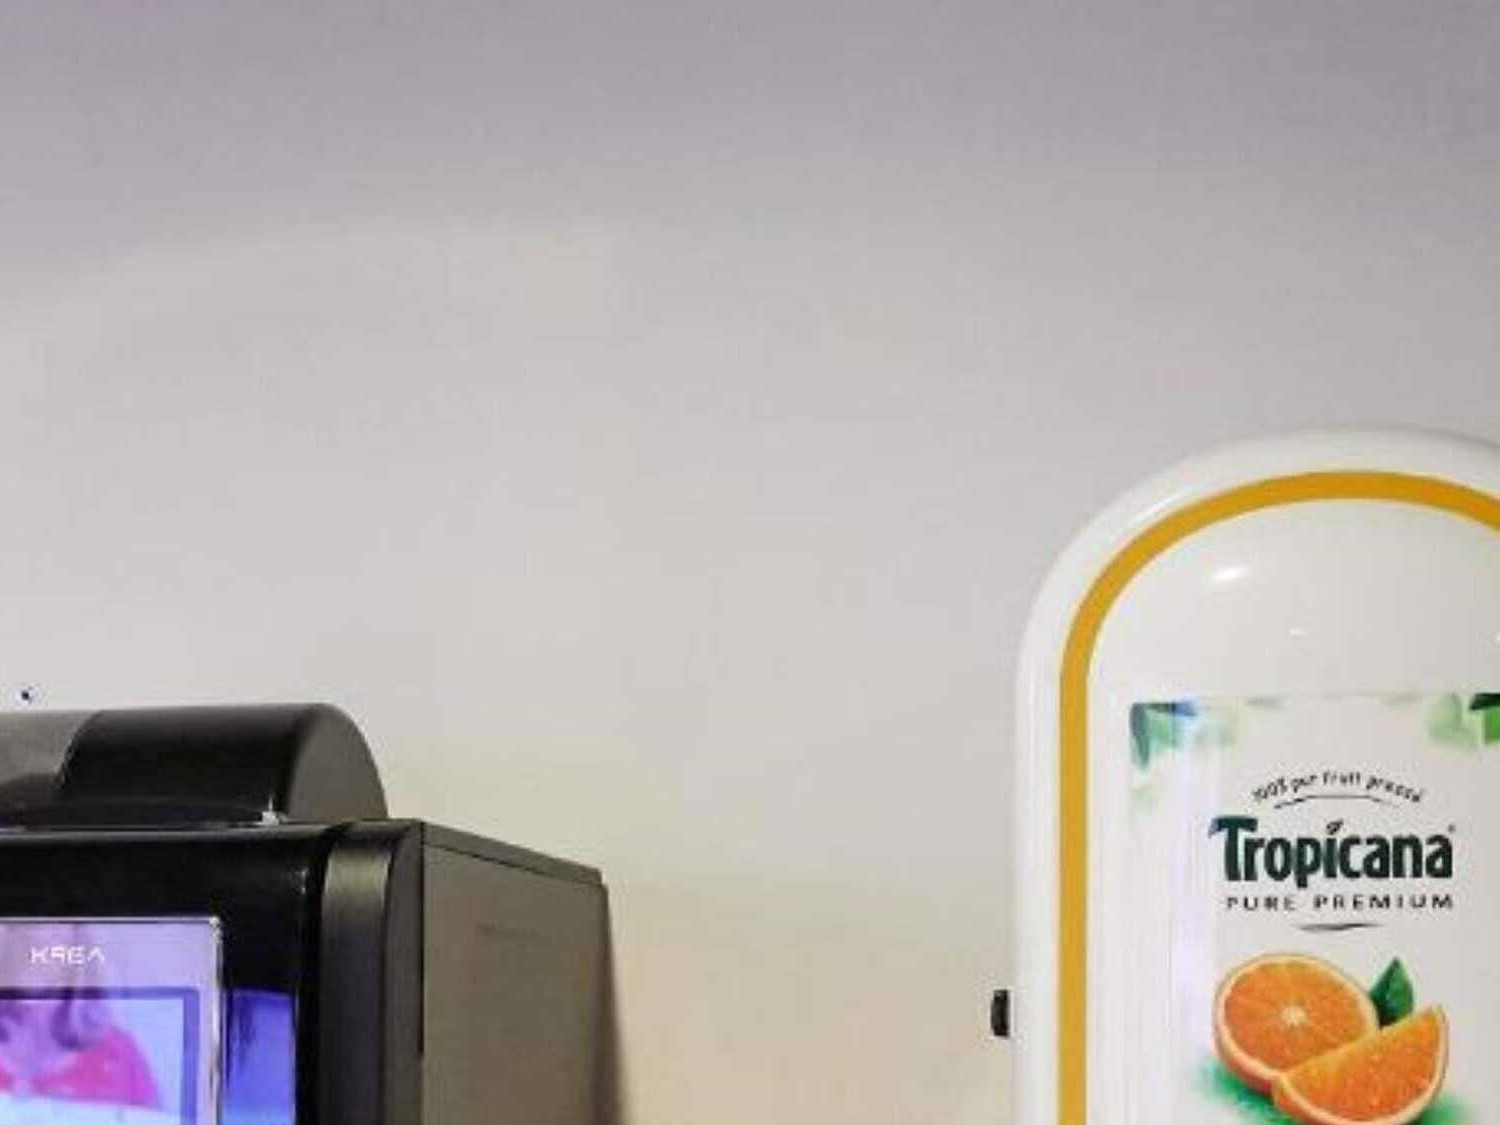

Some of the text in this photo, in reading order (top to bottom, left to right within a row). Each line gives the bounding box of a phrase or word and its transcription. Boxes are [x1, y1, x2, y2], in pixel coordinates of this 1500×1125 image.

[1208, 815, 1454, 889] Tropicana
[1224, 893, 1454, 911] PURE PREMIUM
[30, 945, 106, 965] KREA
